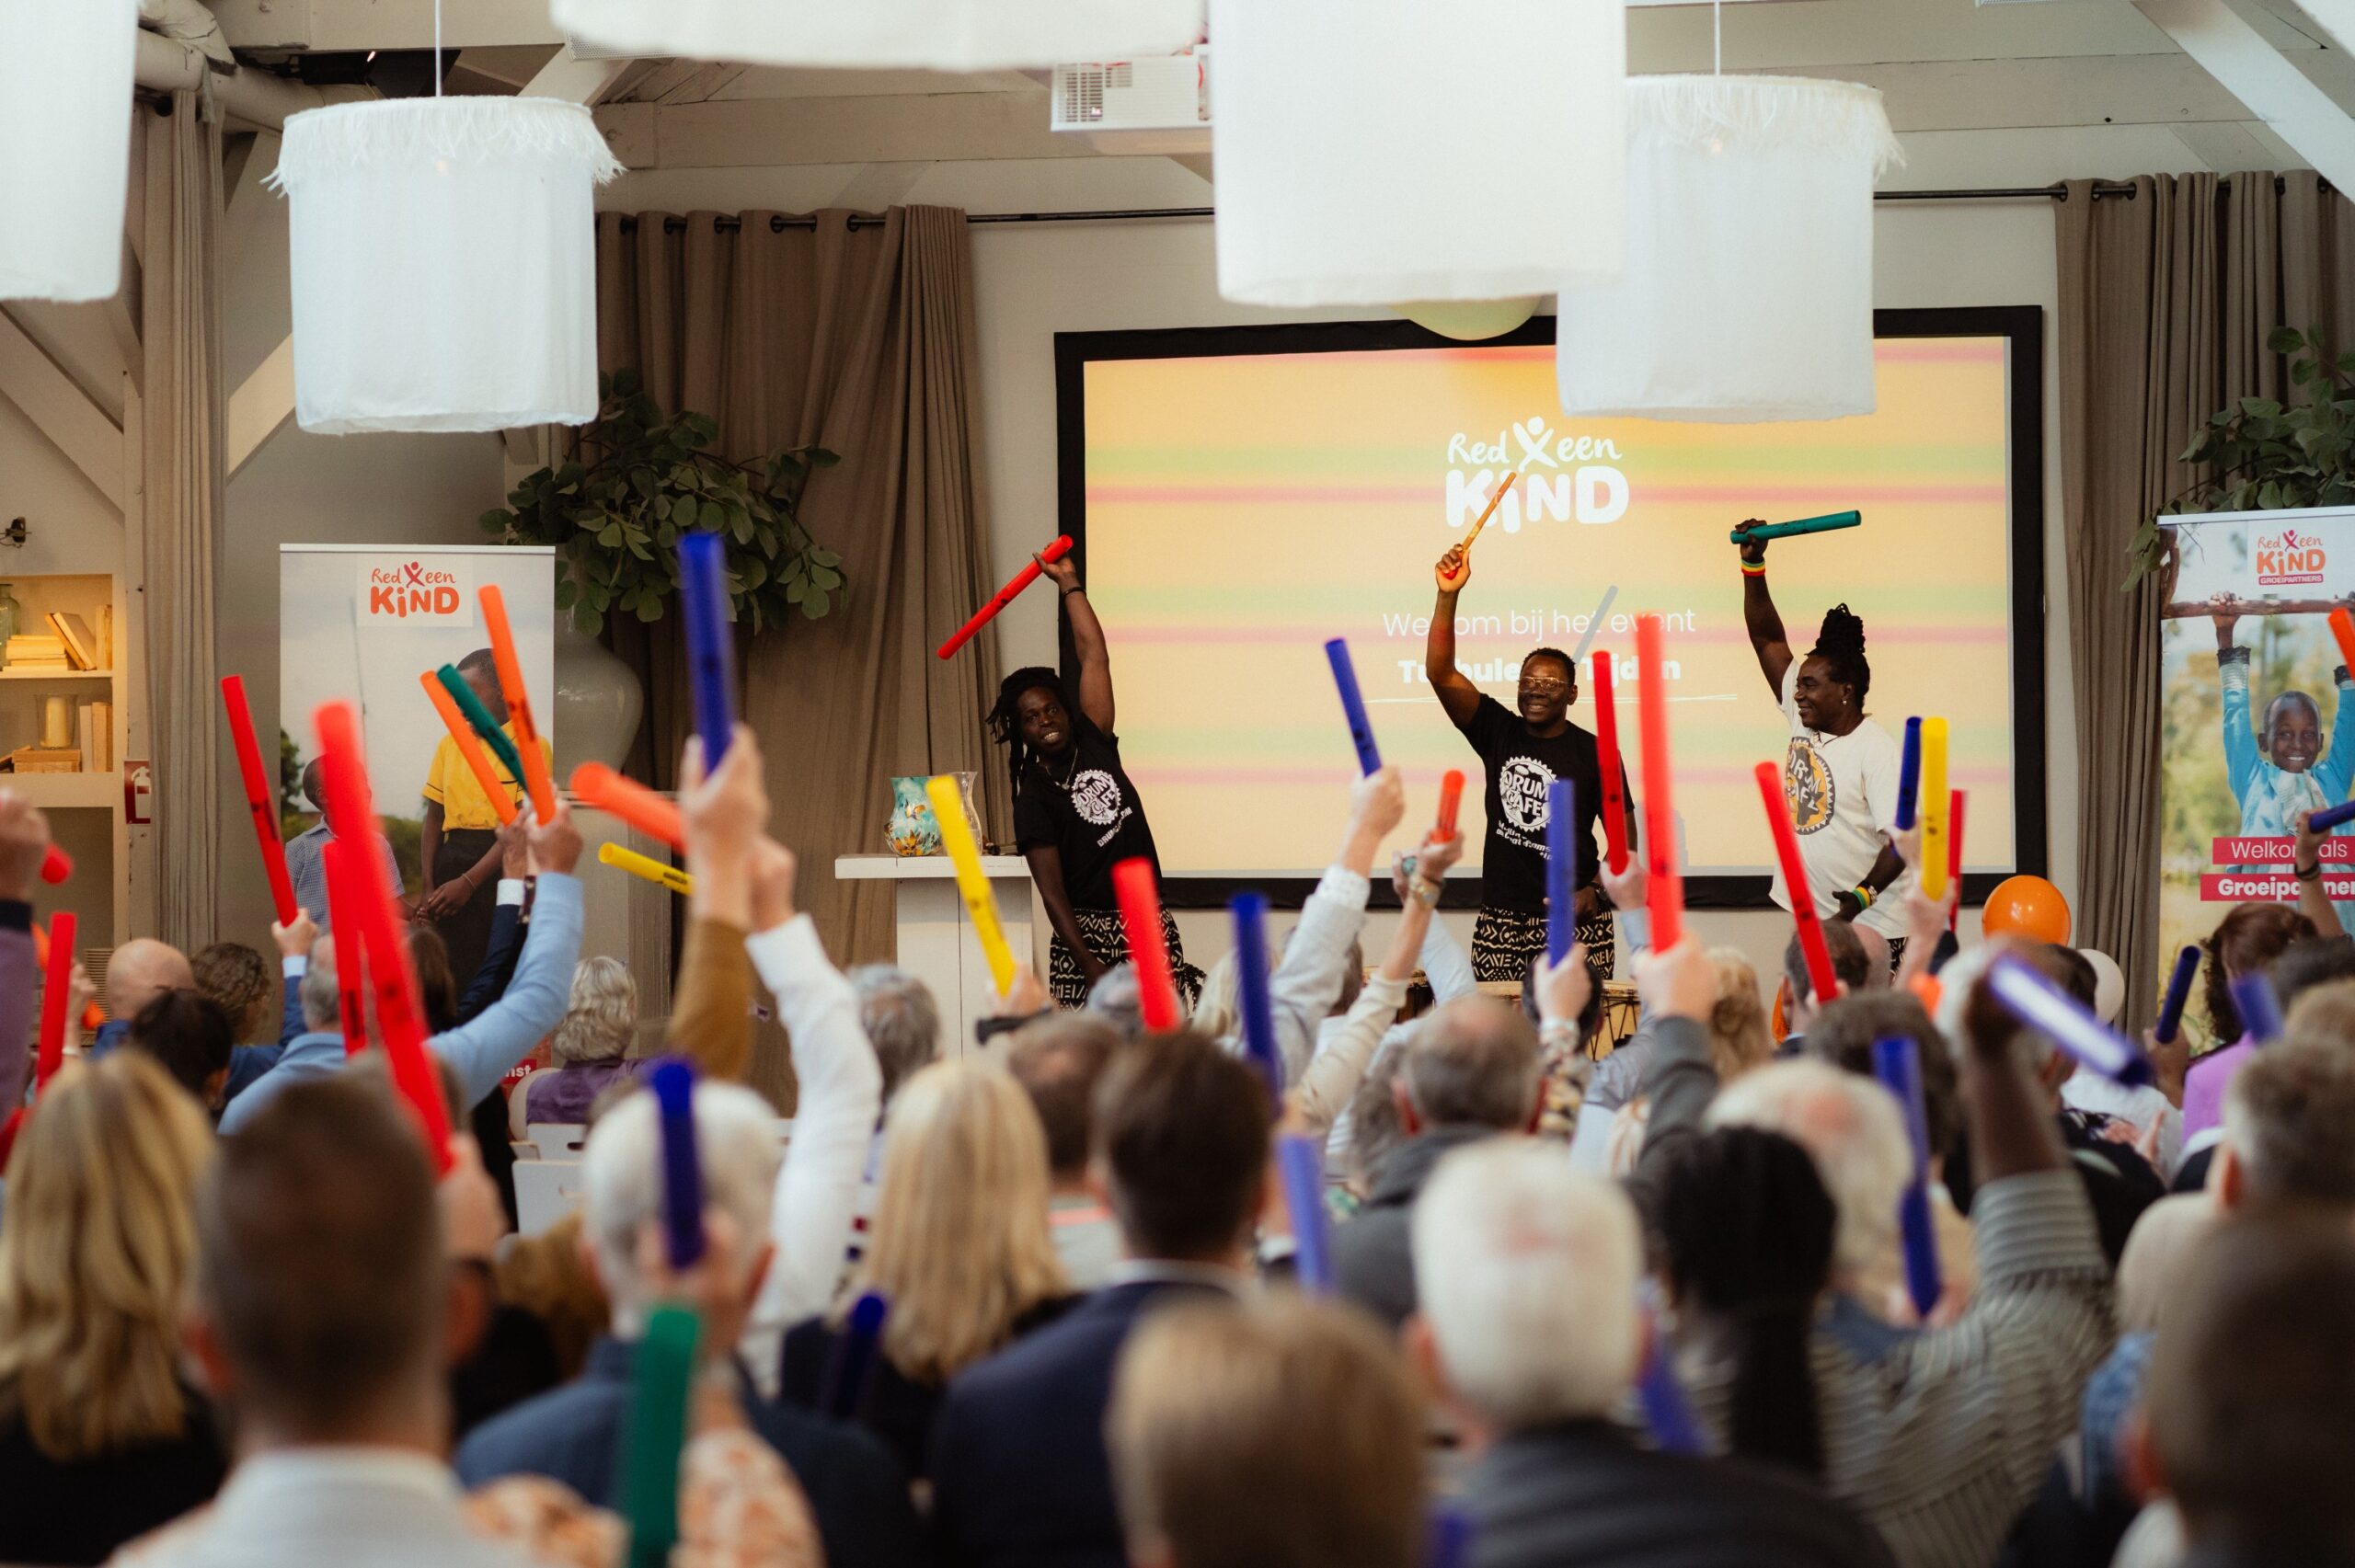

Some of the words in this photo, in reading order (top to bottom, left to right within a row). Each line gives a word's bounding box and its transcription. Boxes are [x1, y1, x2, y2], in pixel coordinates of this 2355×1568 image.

[1447, 431, 1511, 464] Red
[1557, 435, 1623, 462] een
[2257, 535, 2280, 549] Red
[2299, 536, 2324, 547] een
[371, 567, 401, 584] Red
[425, 570, 455, 583] een
[2260, 576, 2322, 584] GROEIPARTNERS
[1383, 612, 1501, 636] Weom
[1511, 610, 1544, 642] bij
[1553, 610, 1602, 634] het
[1581, 653, 1681, 688] Tjdn
[1077, 774, 1111, 806] DRUM
[1503, 770, 1550, 801] DRUM
[1506, 790, 1542, 818] CAFE
[2231, 841, 2296, 859] Welko
[2318, 840, 2348, 858] als
[2218, 876, 2355, 901] Groeipane
